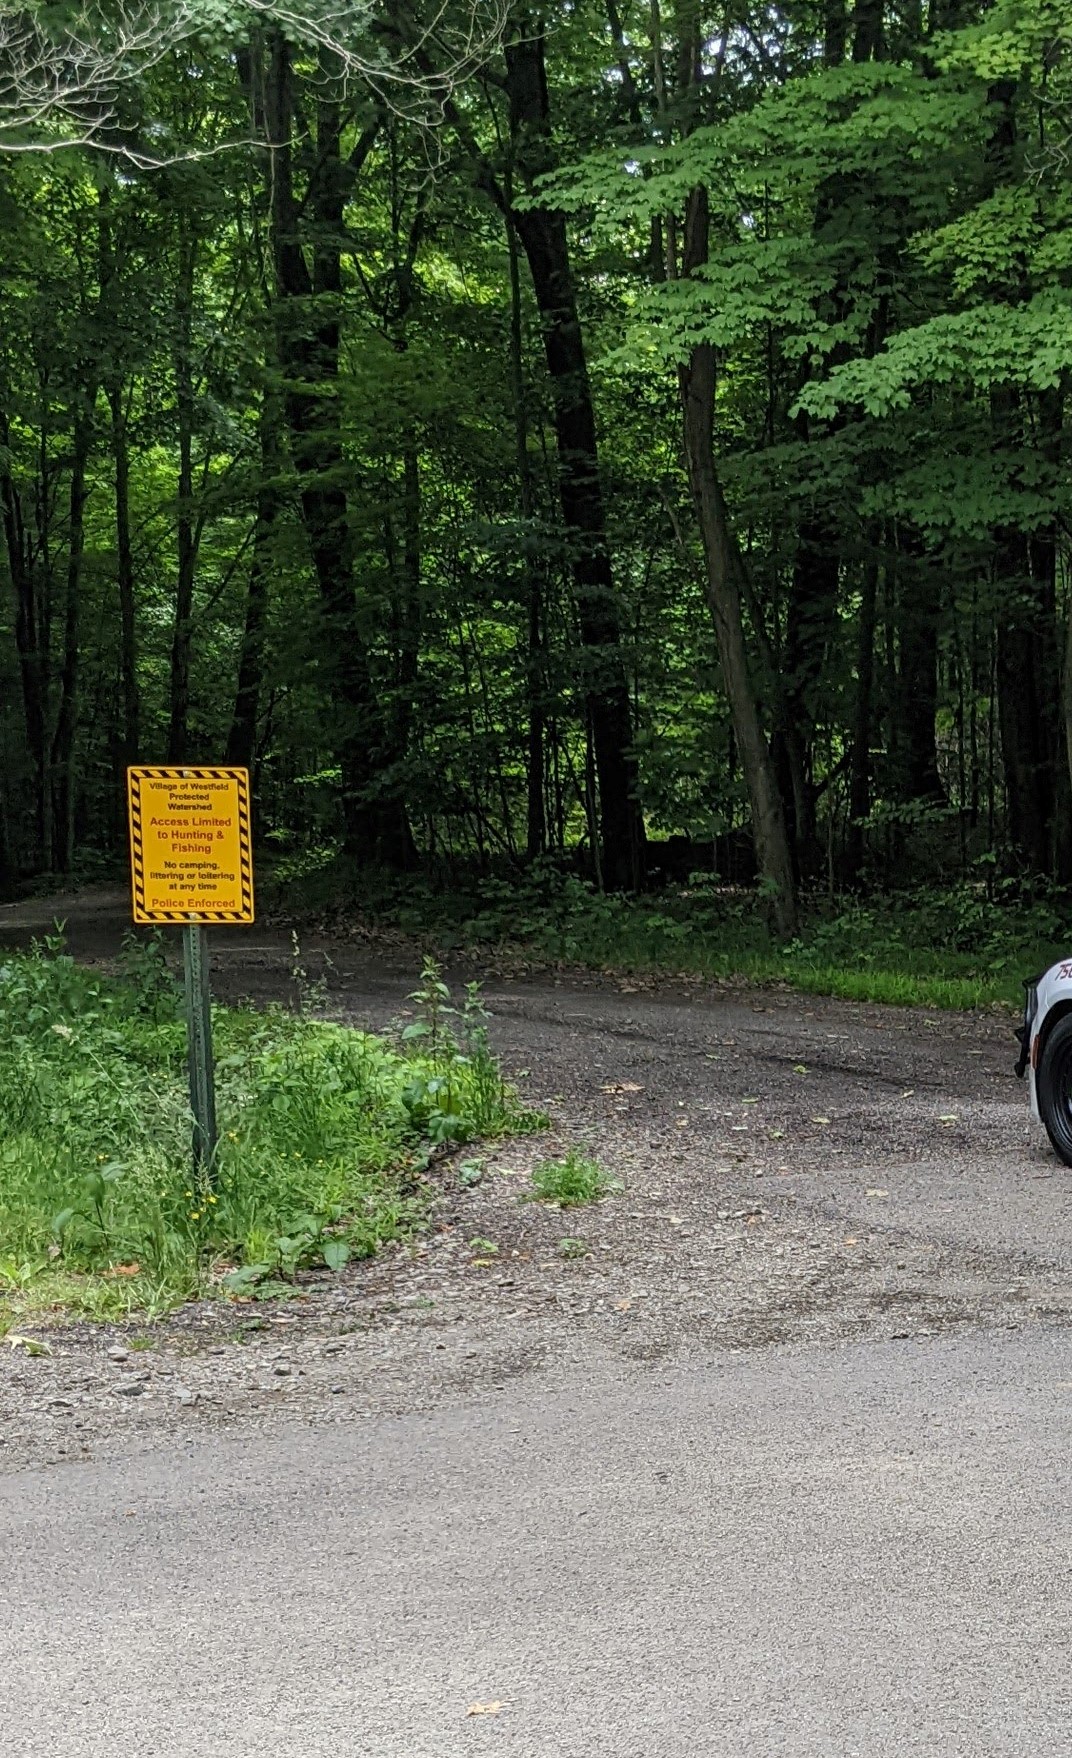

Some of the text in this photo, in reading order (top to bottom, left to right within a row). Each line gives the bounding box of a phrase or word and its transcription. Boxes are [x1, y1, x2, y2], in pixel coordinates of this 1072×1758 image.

[149, 783, 177, 791] Village
[169, 793, 209, 801] Protected
[168, 803, 212, 811] Watershed
[150, 817, 231, 827] Access Limited
[157, 831, 224, 841] to Hunting &
[172, 844, 211, 854] Fishing
[164, 861, 177, 869] No
[150, 872, 184, 881] littering
[198, 872, 235, 881] loitering
[179, 884, 195, 892] any
[152, 899, 235, 908] Police Enforced
